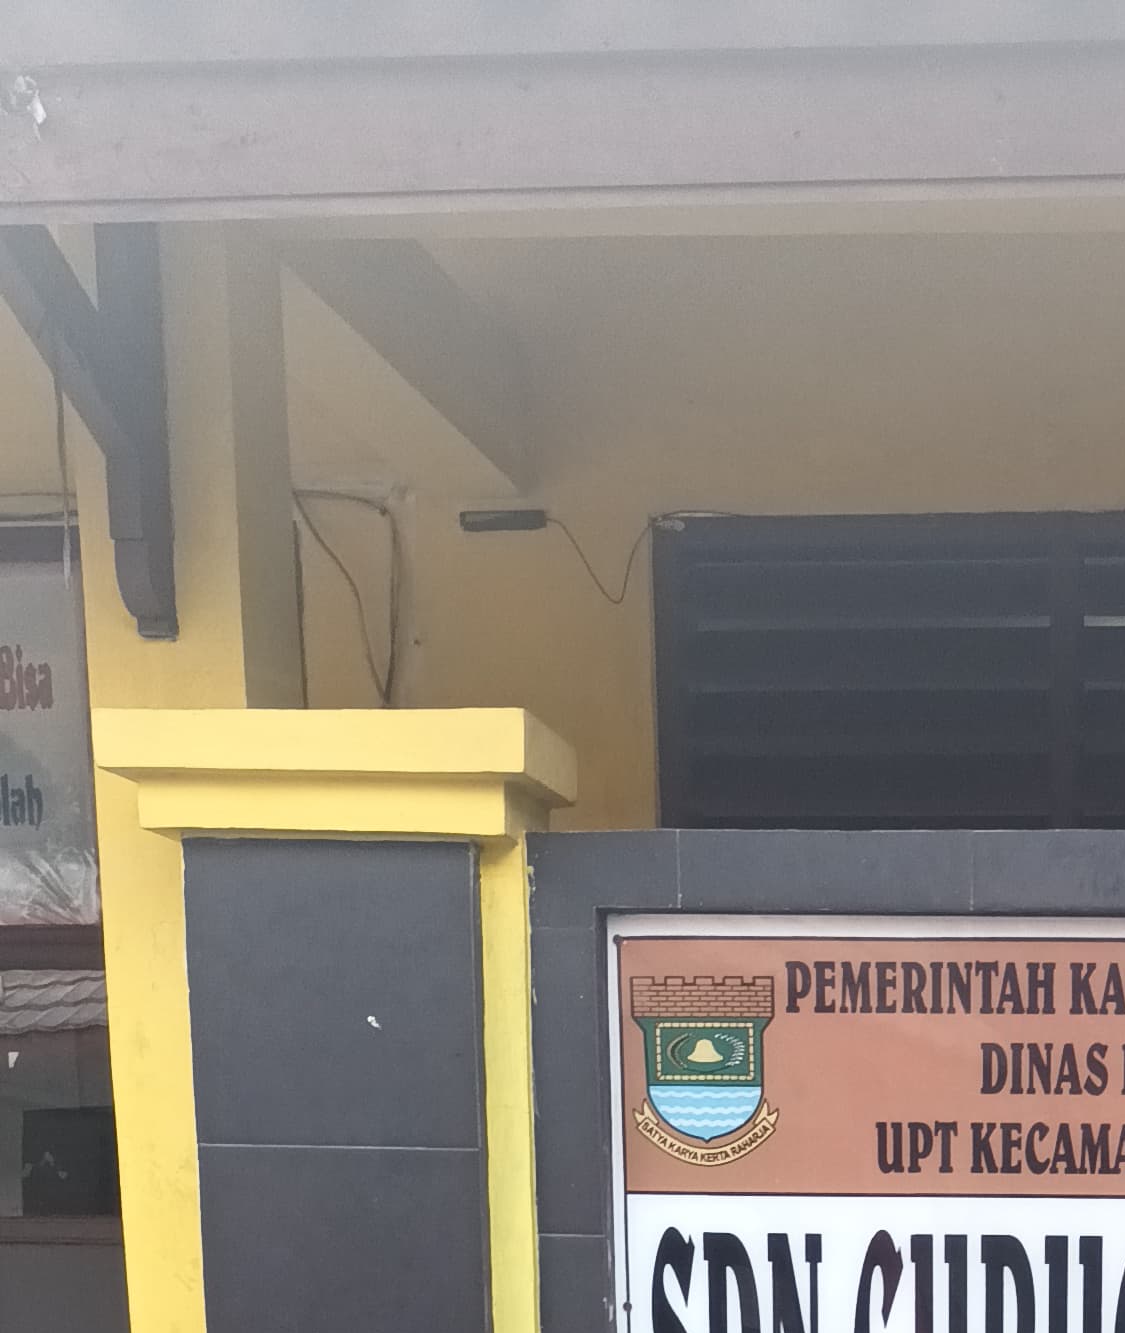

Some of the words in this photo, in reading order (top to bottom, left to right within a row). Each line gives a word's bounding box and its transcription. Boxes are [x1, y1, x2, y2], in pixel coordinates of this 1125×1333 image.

[0, 773, 43, 829] lah
[785, 960, 1057, 1015] PEMERINTAH
[980, 1042, 1109, 1097] DINAS
[642, 1121, 668, 1147] SATYA
[668, 1142, 699, 1162] KARYA
[700, 1151, 731, 1162] KERTA
[731, 1125, 771, 1157] RAHARJA
[875, 1121, 959, 1175] UPT
